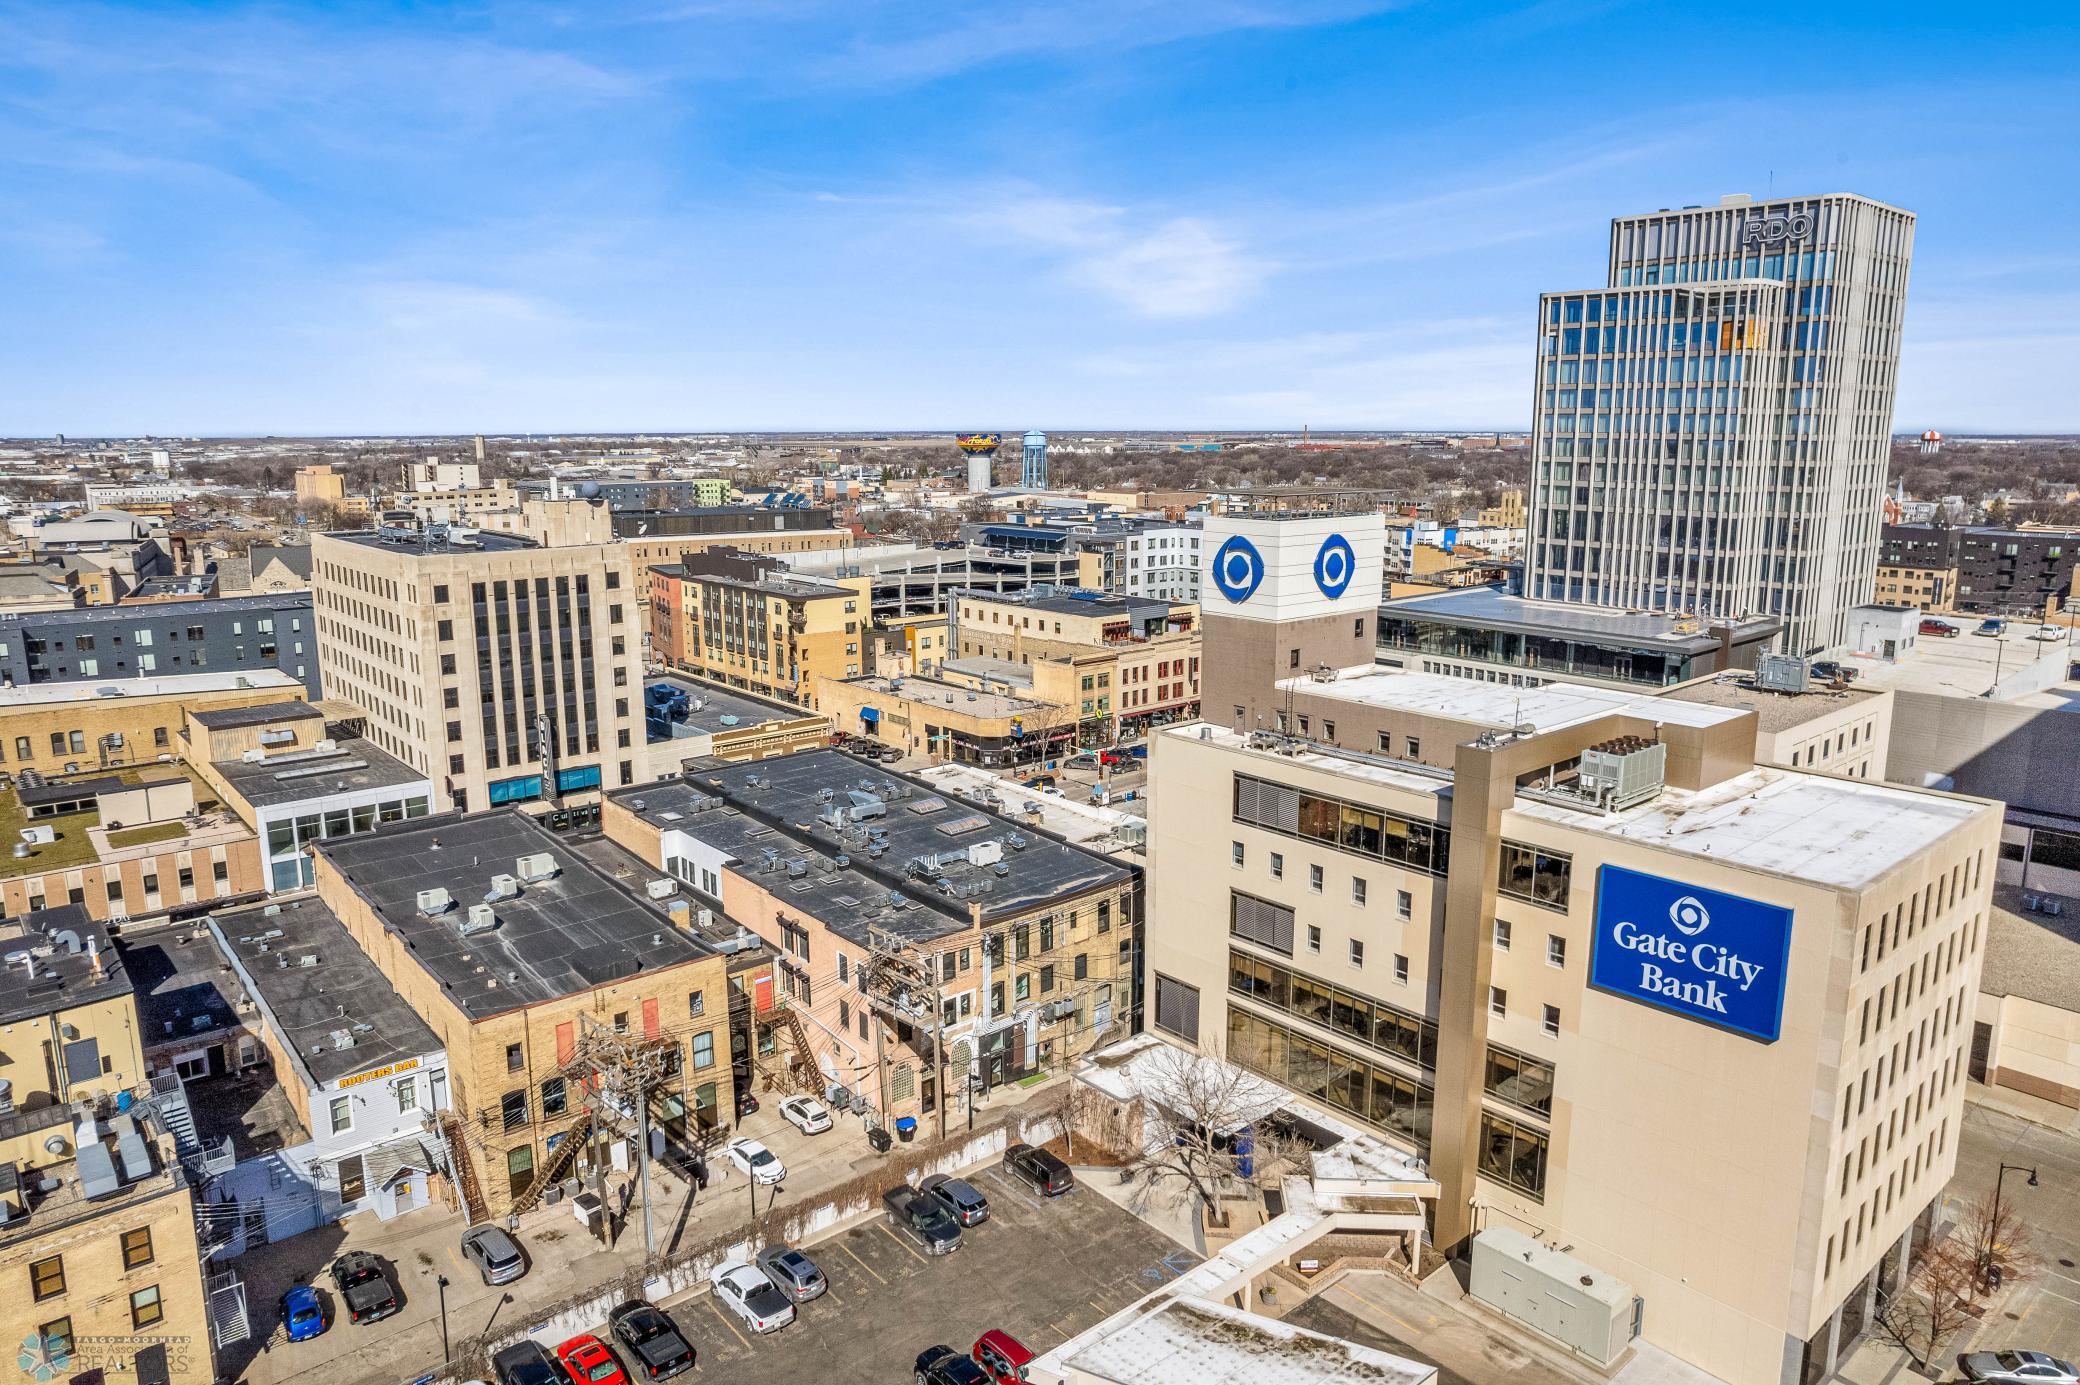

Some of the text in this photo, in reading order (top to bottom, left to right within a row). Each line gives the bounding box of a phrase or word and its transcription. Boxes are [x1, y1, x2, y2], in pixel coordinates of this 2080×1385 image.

[1743, 213, 1814, 244] RDO
[1613, 921, 1764, 992] Gate City
[1638, 962, 1728, 1014] Bank
[339, 1059, 419, 1088] ROOTERS BAR
